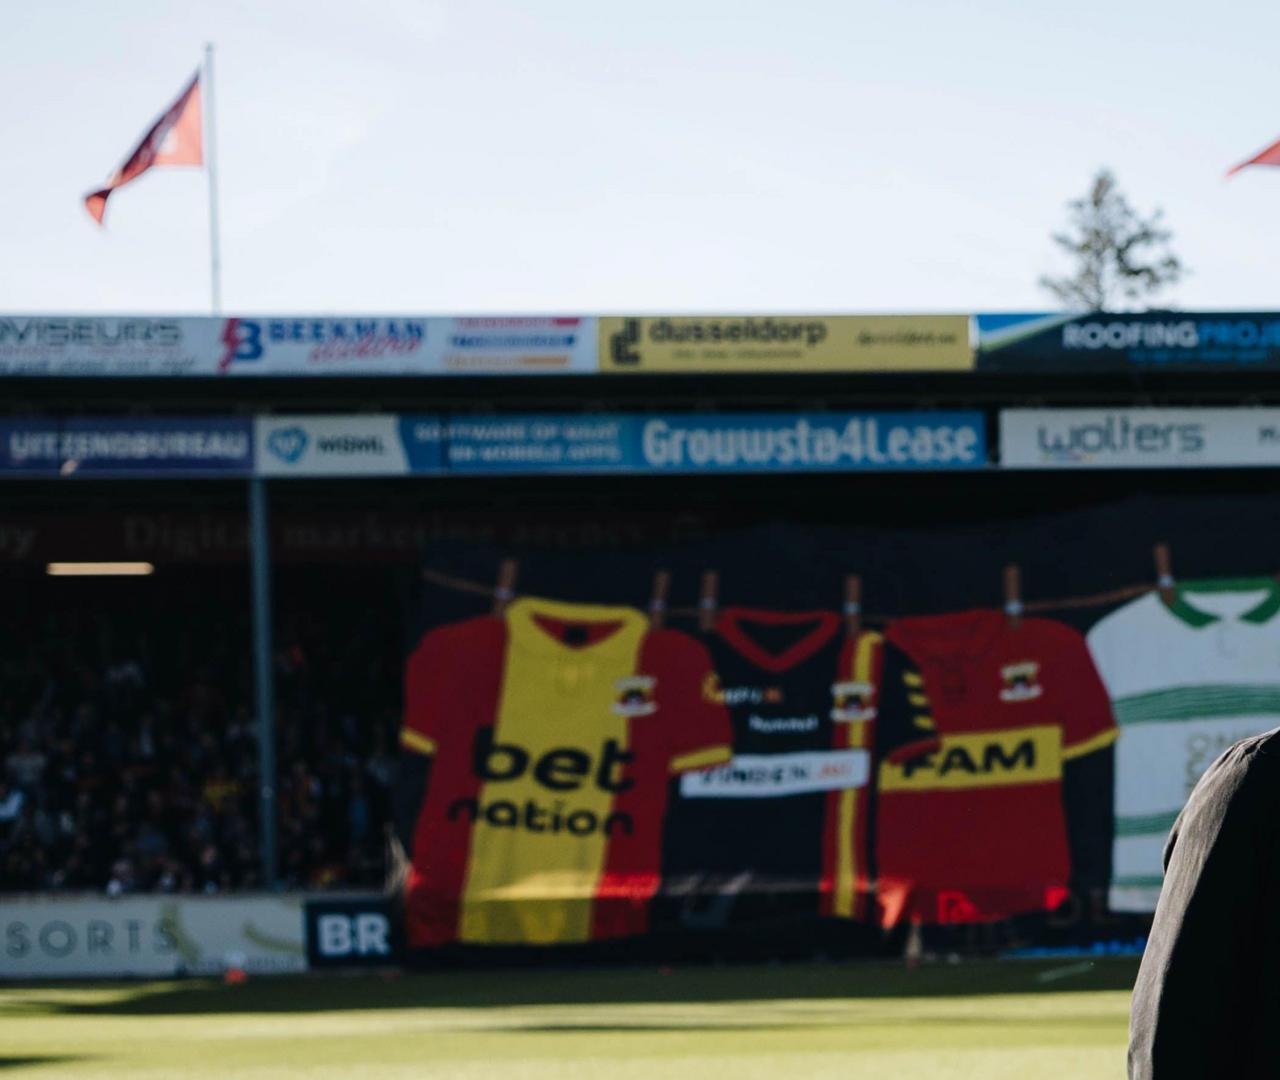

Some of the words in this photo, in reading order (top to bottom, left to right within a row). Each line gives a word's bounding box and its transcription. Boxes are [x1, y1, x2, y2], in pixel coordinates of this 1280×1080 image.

[268, 321, 425, 343] BEEKMAN
[648, 319, 827, 347] dusseldorp
[9, 430, 249, 461] UITZENDBUREAU
[642, 417, 979, 466] Grouwsta4Lease
[1036, 415, 1206, 453] wolters
[122, 513, 262, 556] Digita
[473, 727, 637, 792] bet
[446, 795, 638, 838] nation
[315, 910, 393, 957] BR
